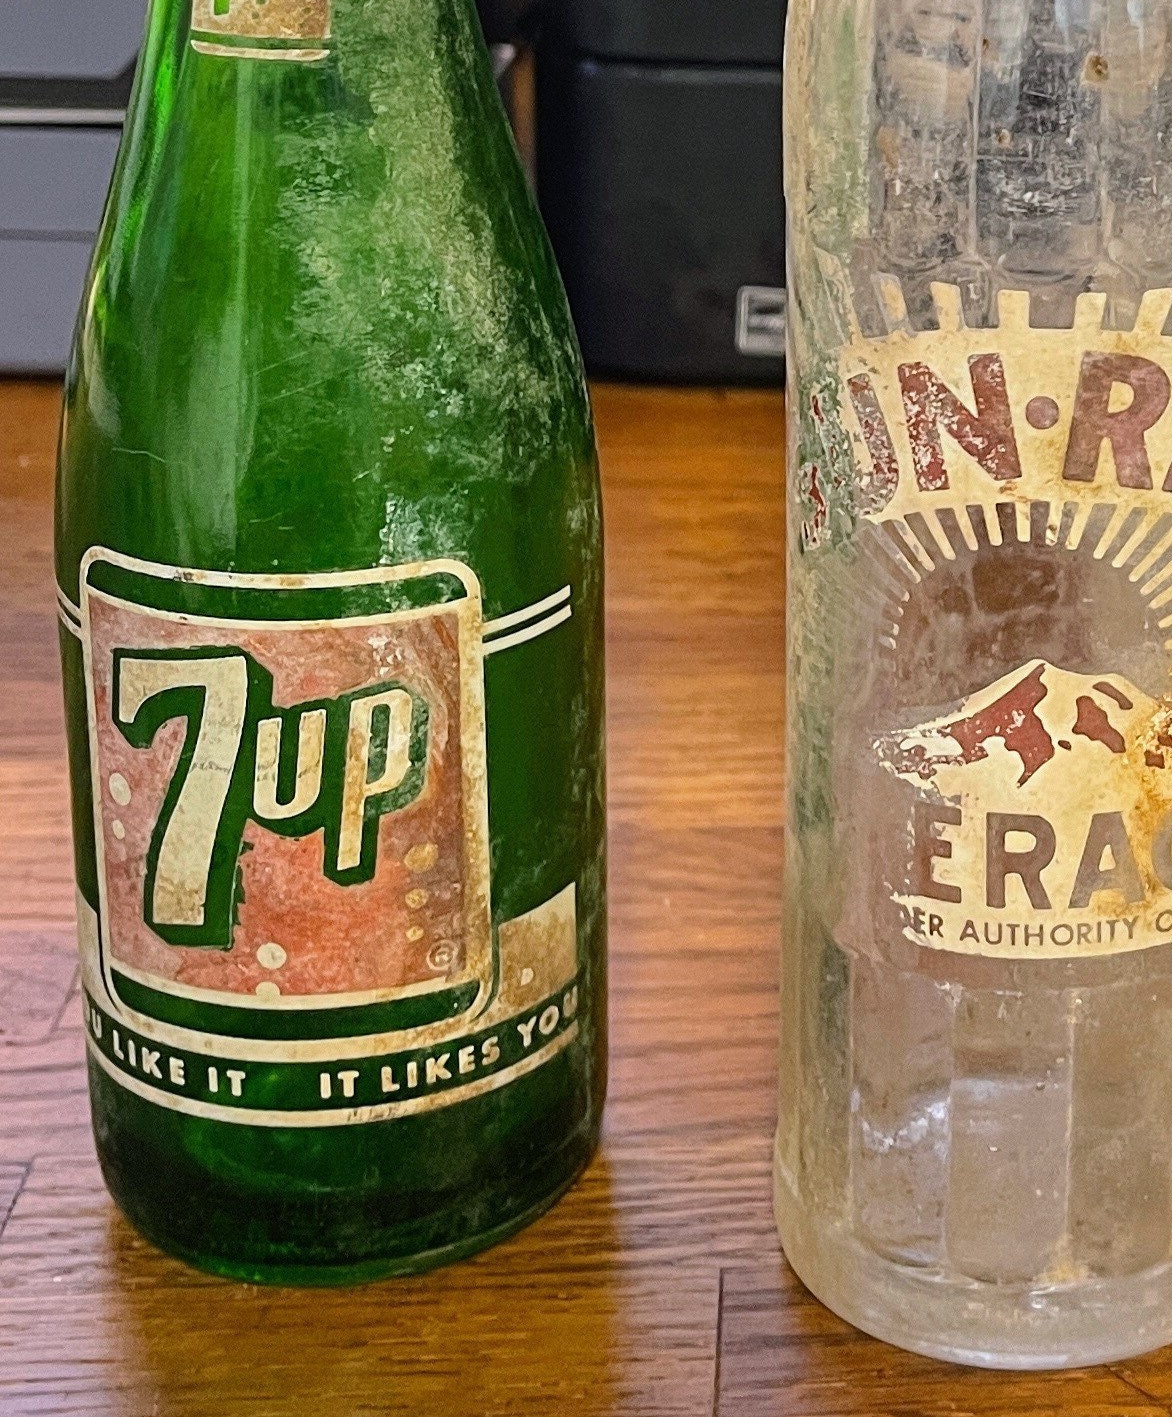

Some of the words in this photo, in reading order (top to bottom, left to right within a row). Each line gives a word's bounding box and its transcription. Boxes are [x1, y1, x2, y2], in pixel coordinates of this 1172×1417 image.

[959, 917, 1140, 948] AUTHORITY
[112, 1028, 186, 1086] LIKE
[207, 1065, 247, 1097] IT
[319, 1069, 360, 1100] IT
[380, 1035, 501, 1093] LIKES
[516, 985, 579, 1048] YOU
